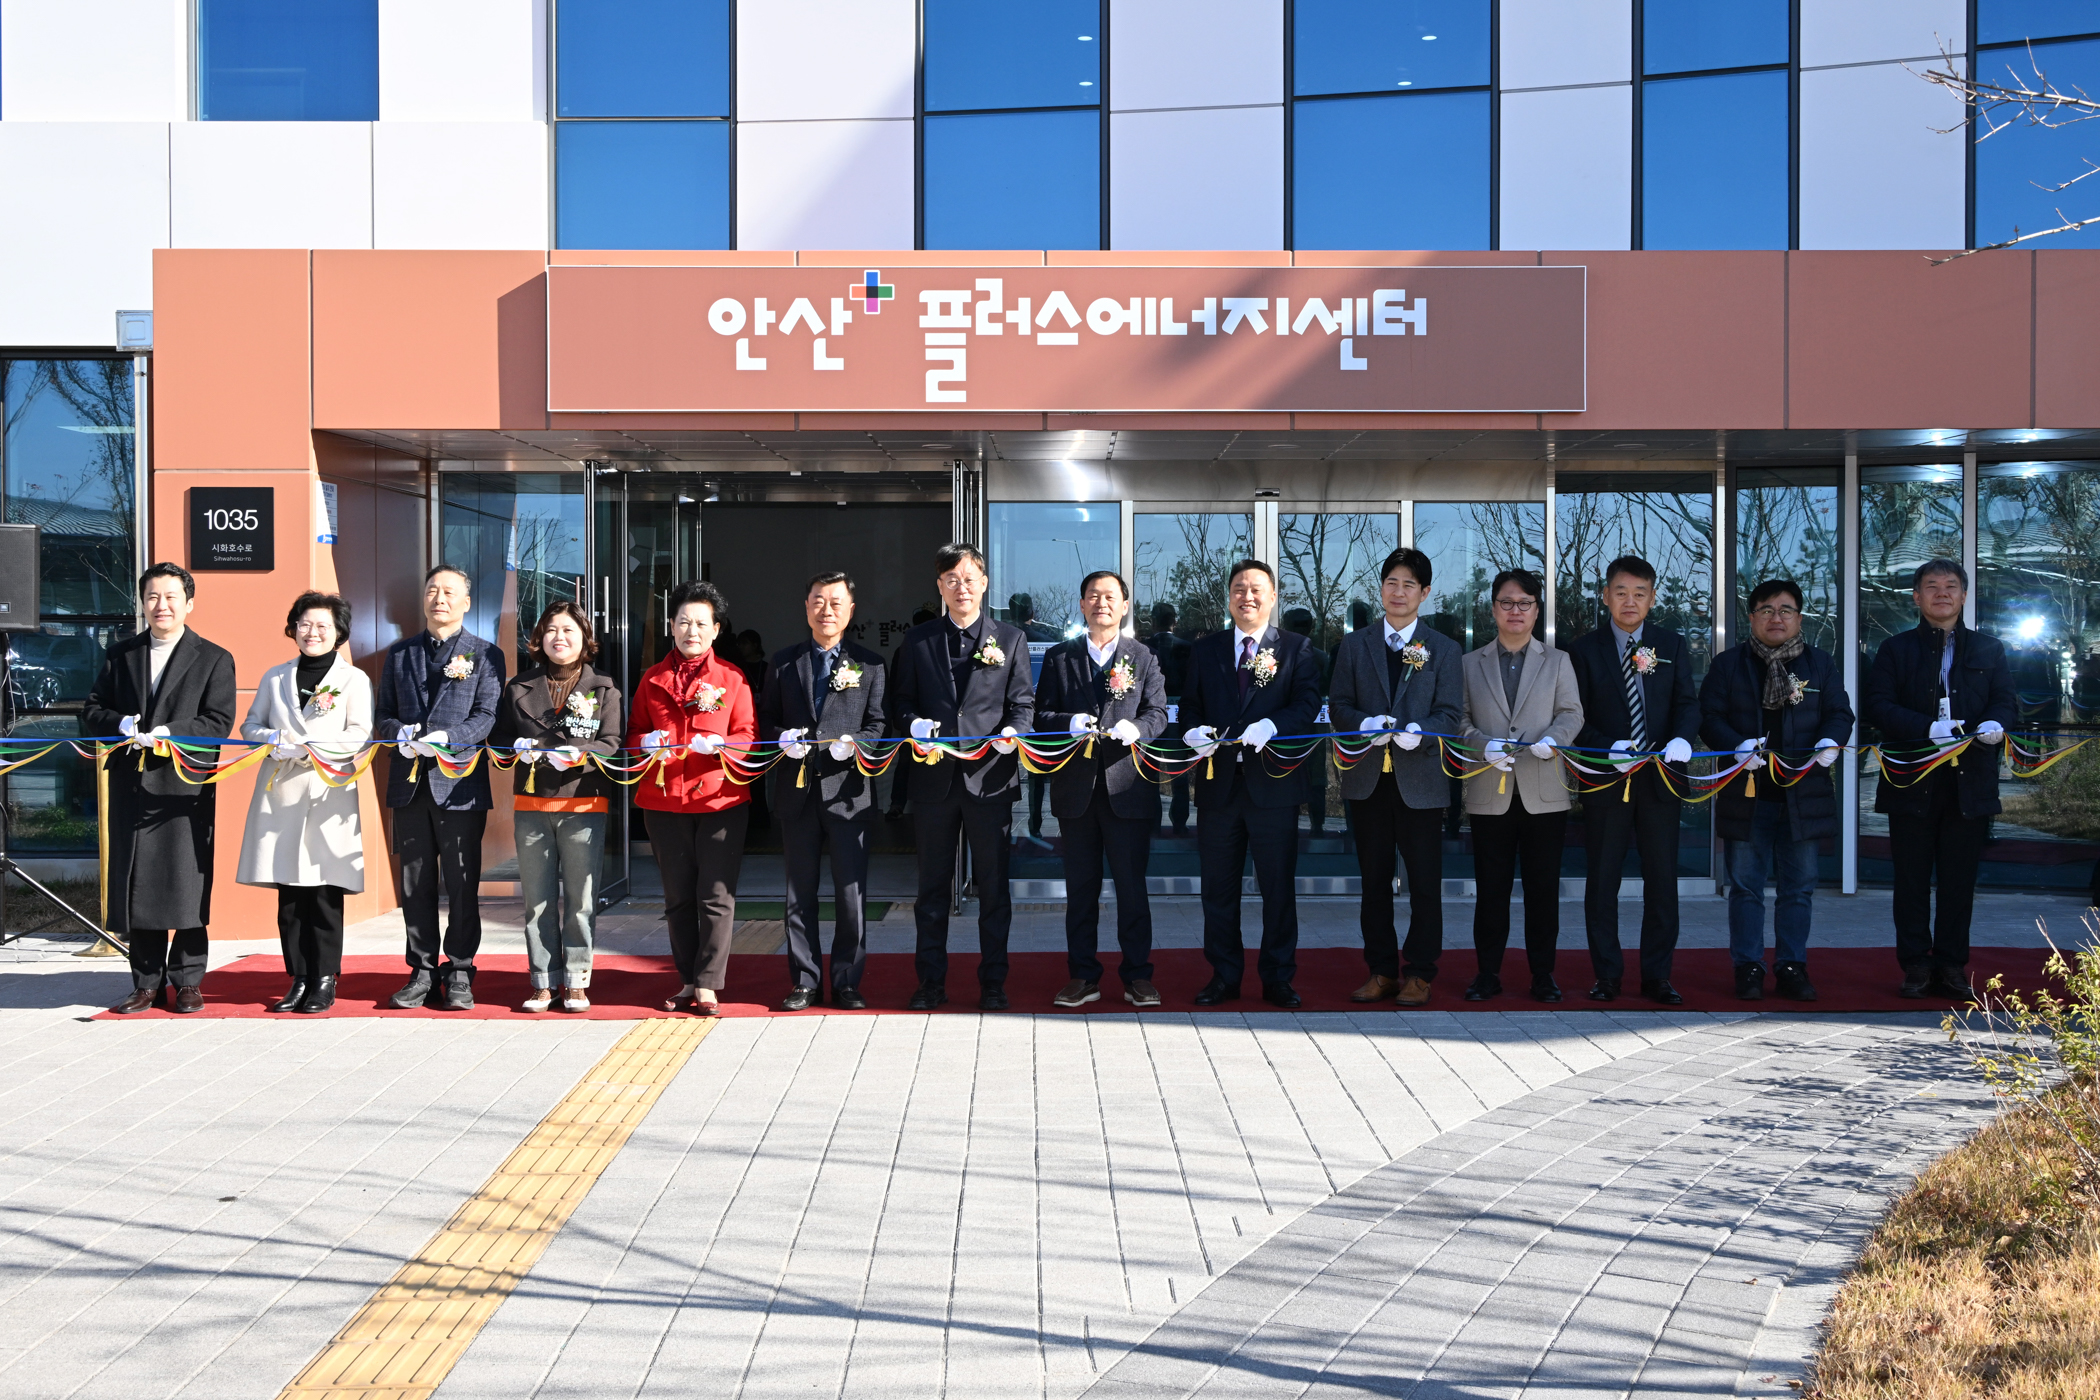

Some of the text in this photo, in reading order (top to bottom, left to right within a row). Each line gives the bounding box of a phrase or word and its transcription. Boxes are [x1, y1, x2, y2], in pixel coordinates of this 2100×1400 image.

[707, 277, 1428, 403] 안산 플러스에너지센터
[203, 508, 259, 531] 1035
[211, 543, 253, 553] 시화호수로
